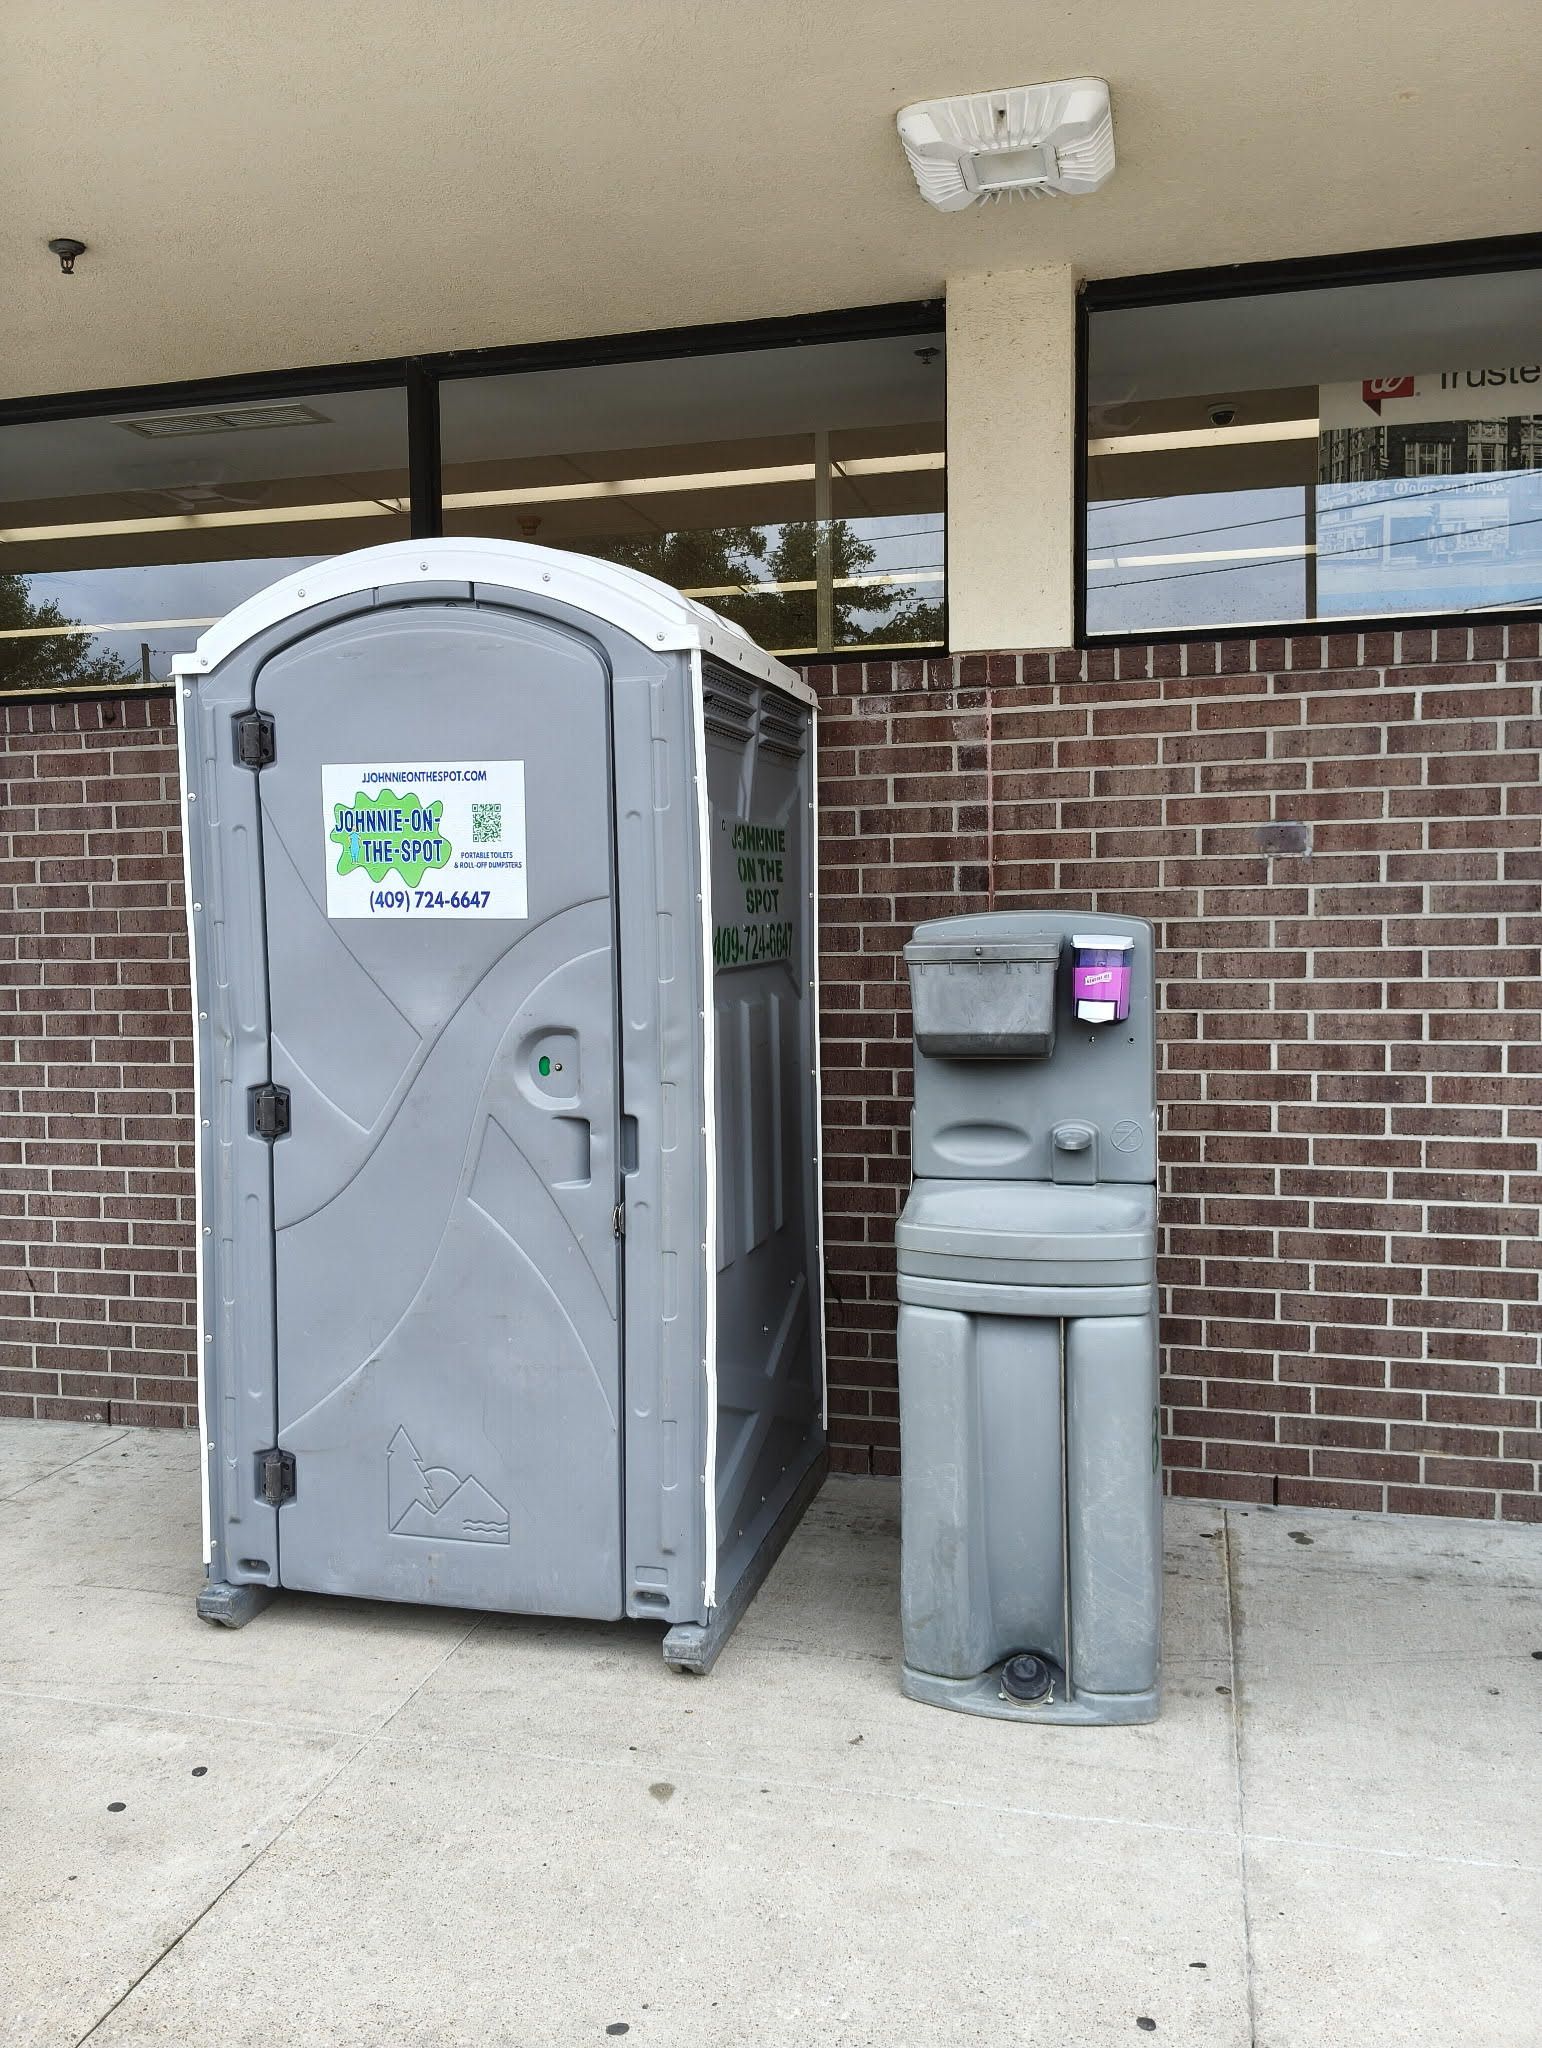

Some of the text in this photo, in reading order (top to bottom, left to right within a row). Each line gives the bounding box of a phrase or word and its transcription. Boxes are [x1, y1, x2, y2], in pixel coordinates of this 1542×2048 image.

[362, 770, 487, 783] JJOHNNIEONTHESPOT.COM
[731, 824, 785, 853] JOHNNIE
[362, 839, 443, 862] THE-SPOT
[460, 851, 513, 859] PORTABLE TOILETS
[460, 861, 488, 869] ROLL-OFF
[488, 861, 523, 869] DUMPSTERS
[737, 857, 784, 883] ON THE
[369, 890, 491, 913] (409) 724-6647
[745, 888, 779, 914] SPOT
[712, 922, 793, 966] 409-724-6647
